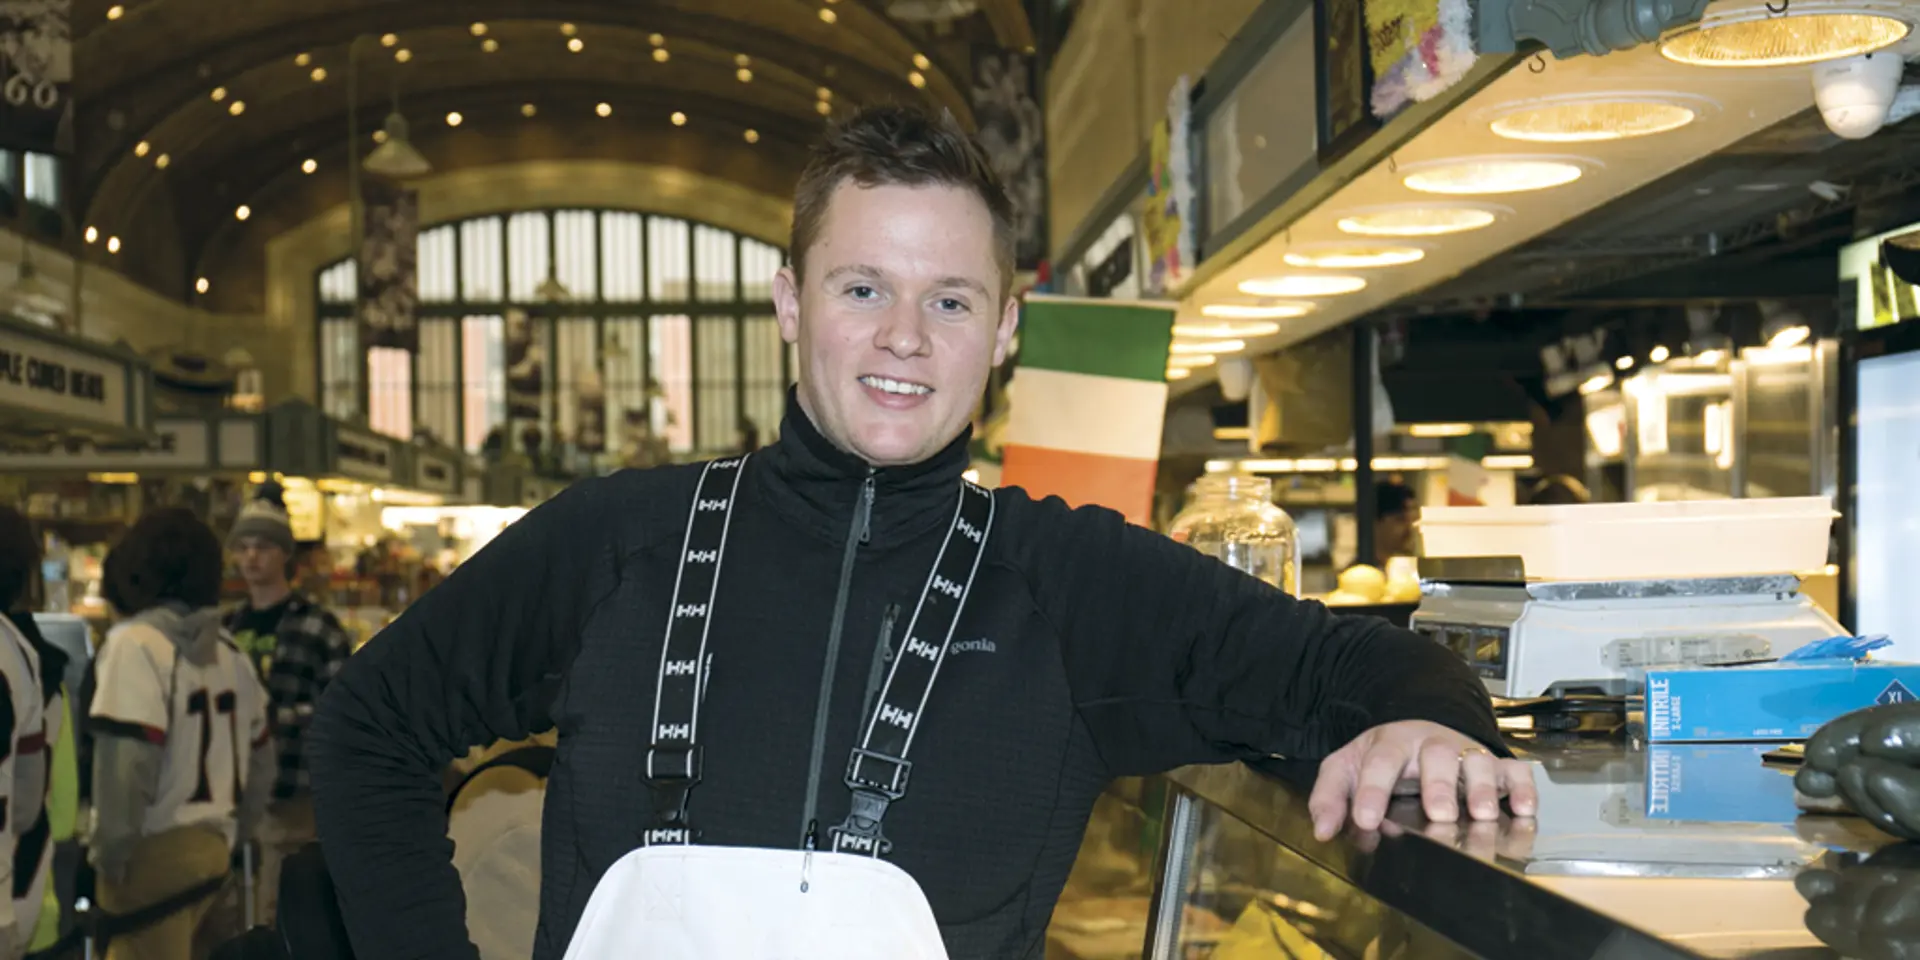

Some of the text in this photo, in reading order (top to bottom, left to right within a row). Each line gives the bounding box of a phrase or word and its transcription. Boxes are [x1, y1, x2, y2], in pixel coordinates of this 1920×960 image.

[698, 498, 728, 511] HH
[958, 517, 982, 543] HH
[687, 549, 717, 564] HH
[933, 574, 963, 599] HH
[676, 603, 707, 618] HH
[907, 636, 940, 661] HH
[665, 659, 696, 676] HH
[879, 703, 914, 730] HH
[1650, 678, 1670, 738] NITRILE
[658, 723, 689, 740] HH
